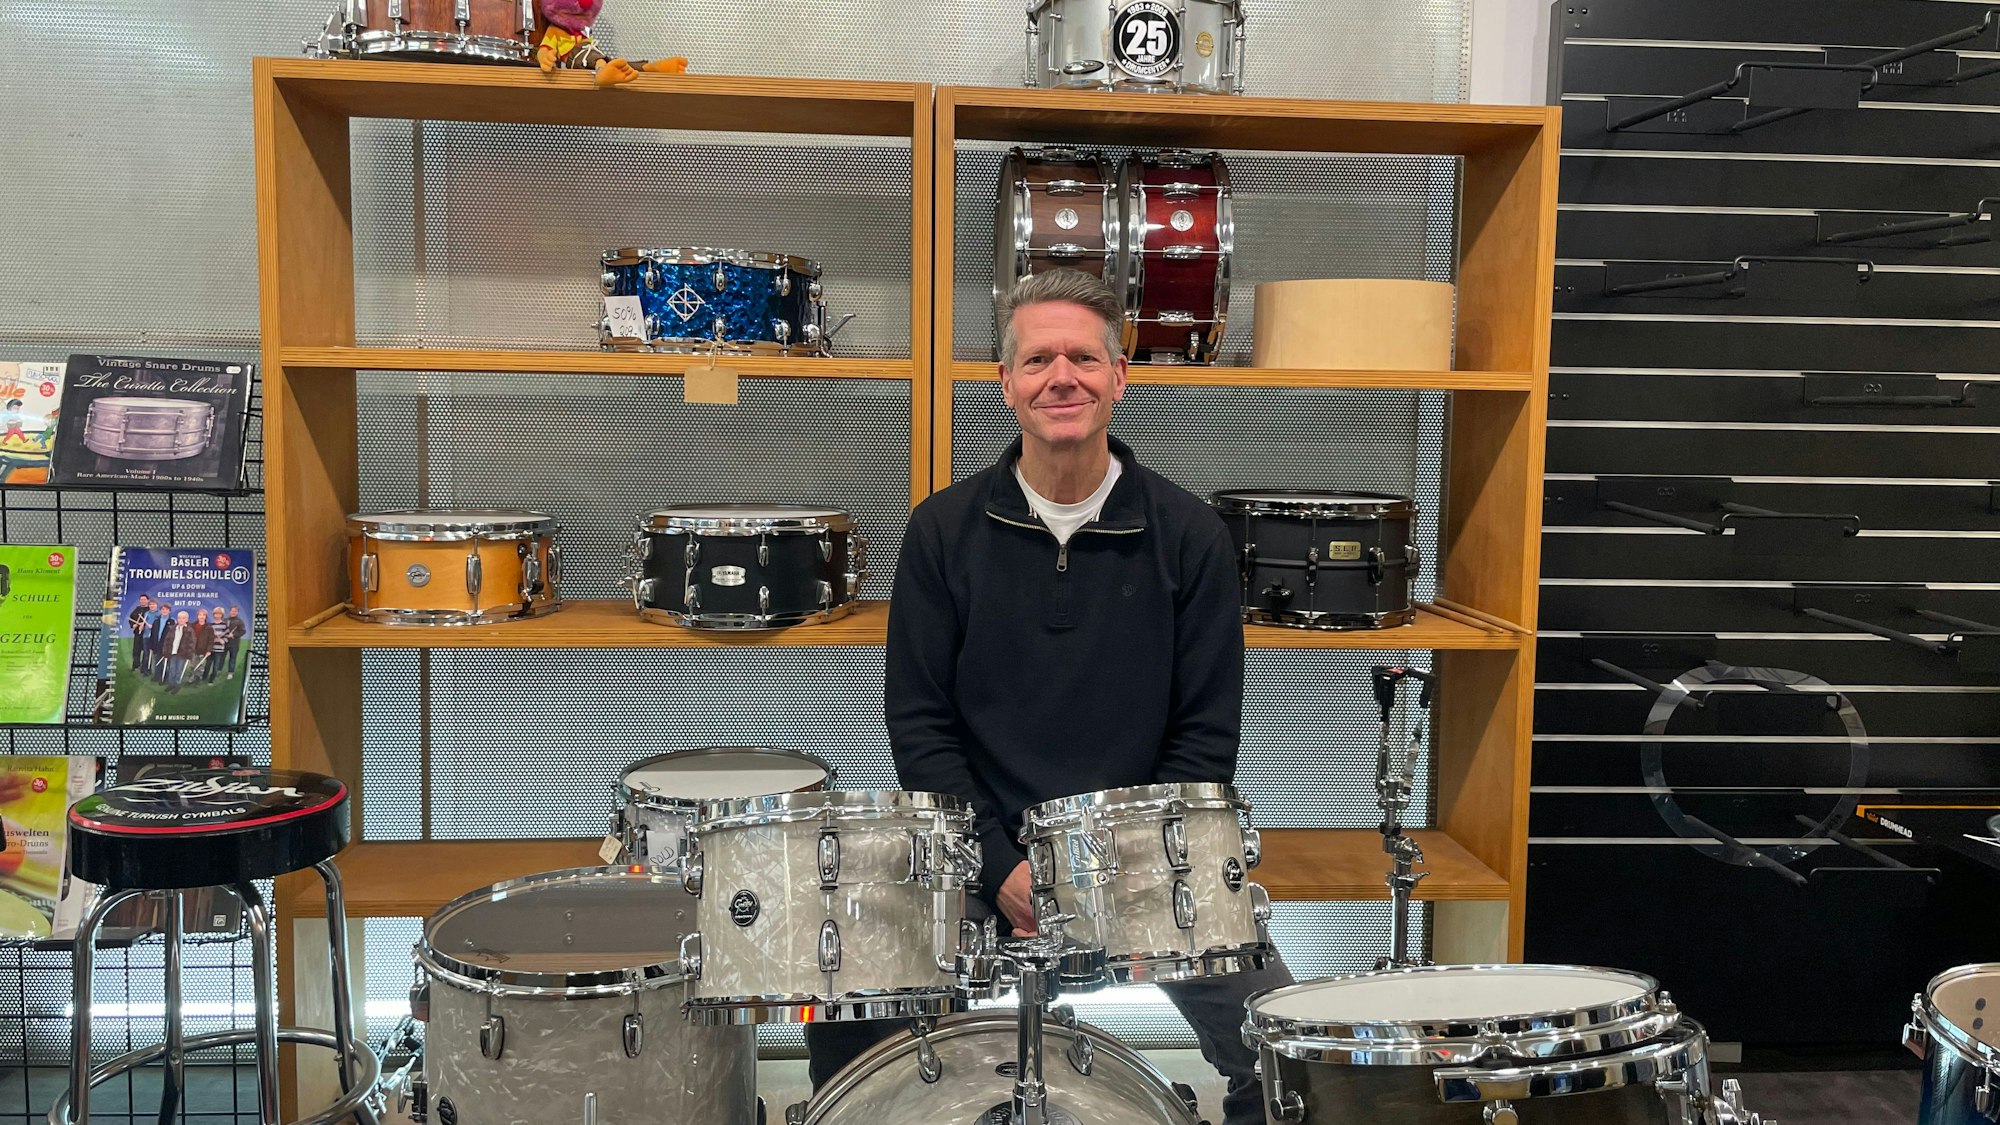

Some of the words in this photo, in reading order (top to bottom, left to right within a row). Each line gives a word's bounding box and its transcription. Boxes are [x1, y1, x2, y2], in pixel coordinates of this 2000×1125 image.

[1127, 3, 1144, 14] 1983
[1151, 3, 1168, 17] 2008
[1126, 20, 1167, 56] 25
[1137, 55, 1155, 63] JAHRE
[1126, 61, 1167, 74] DRUMCENTER
[612, 306, 637, 321] 50%
[98, 359, 142, 369] Vintage
[145, 361, 178, 371] Snare
[181, 364, 221, 373] Drums
[73, 372, 112, 388] The
[169, 376, 238, 395] Collection
[170, 557, 209, 567] BASLER
[129, 569, 231, 580] TROMMELSCHULE
[234, 571, 247, 580] D1
[12, 594, 61, 603] SCHULE
[0, 633, 57, 644] GZEUG
[127, 811, 180, 820] TURKISH
[182, 807, 247, 820] CYMBALS
[1880, 817, 1913, 838] DRUMHEAD
[649, 846, 675, 866] SOLD
